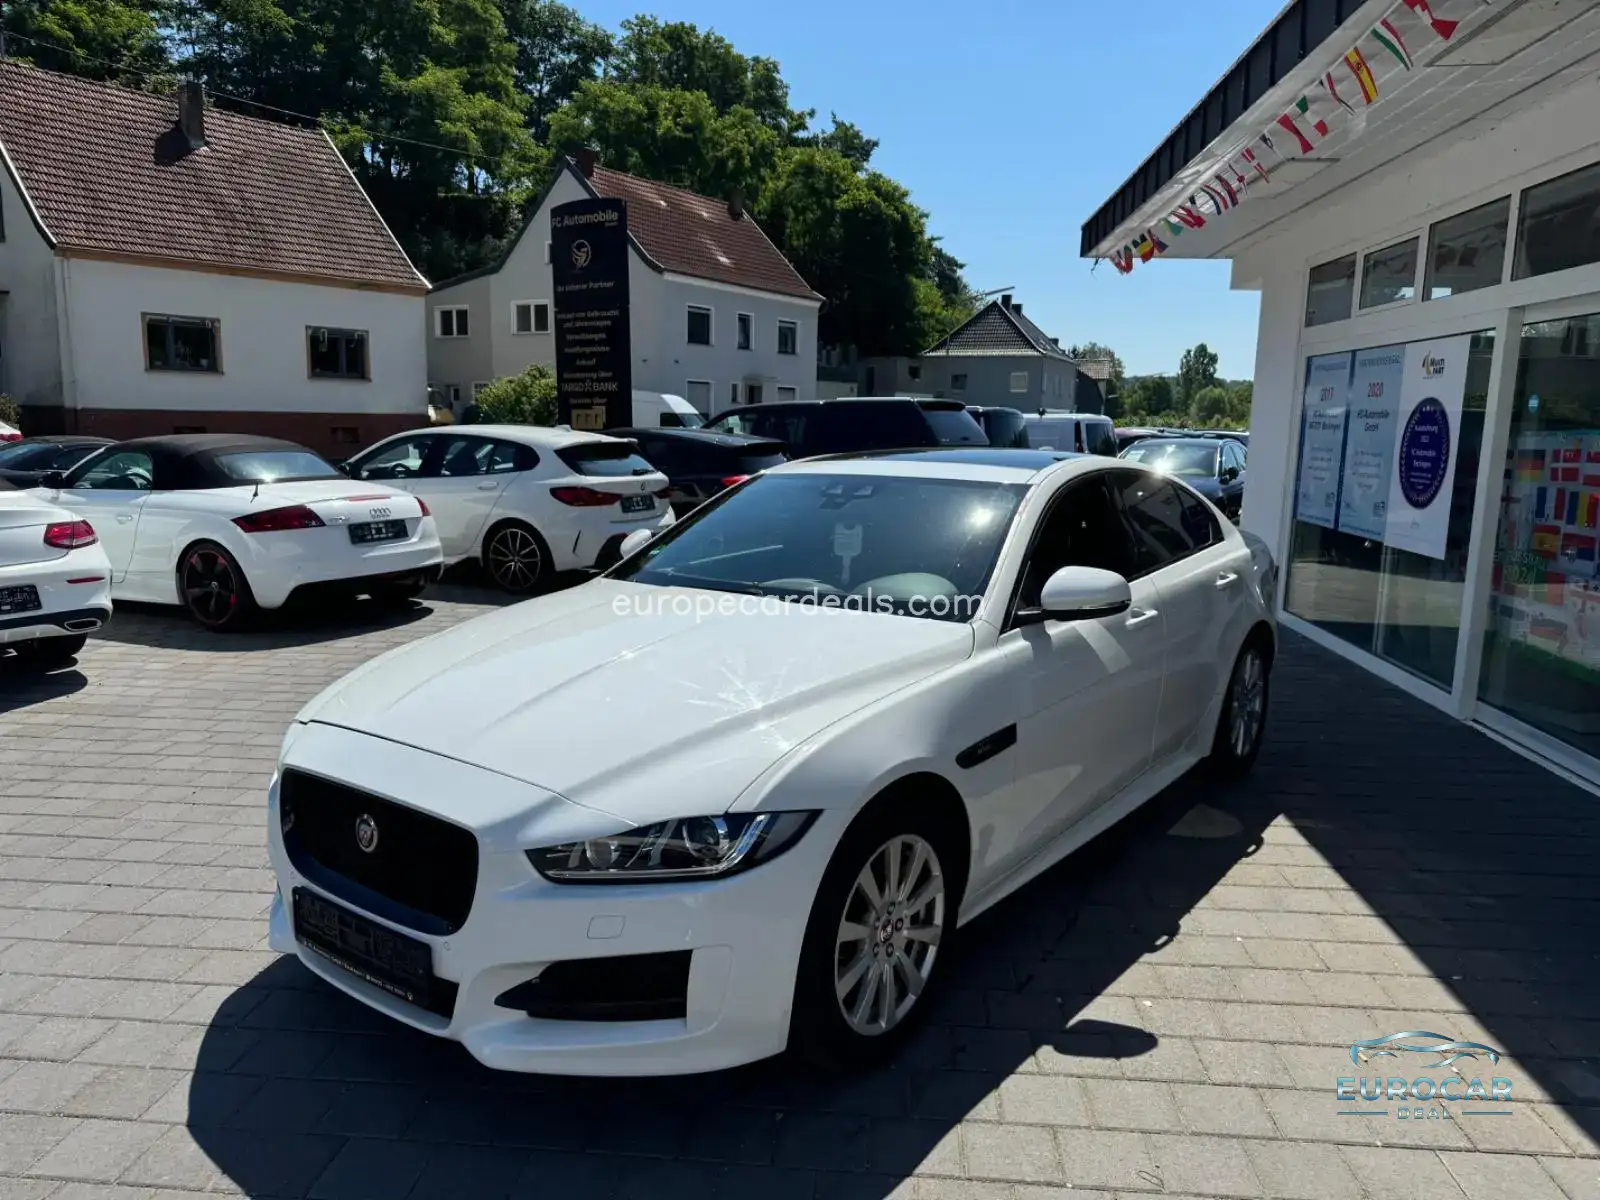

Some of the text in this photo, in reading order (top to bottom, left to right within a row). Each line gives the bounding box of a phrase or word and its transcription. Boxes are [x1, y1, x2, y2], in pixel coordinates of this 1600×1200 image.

[563, 210, 618, 227] Automobile
[1433, 367, 1444, 375] PART
[593, 382, 619, 391] BANK
[1367, 381, 1384, 398] 2020
